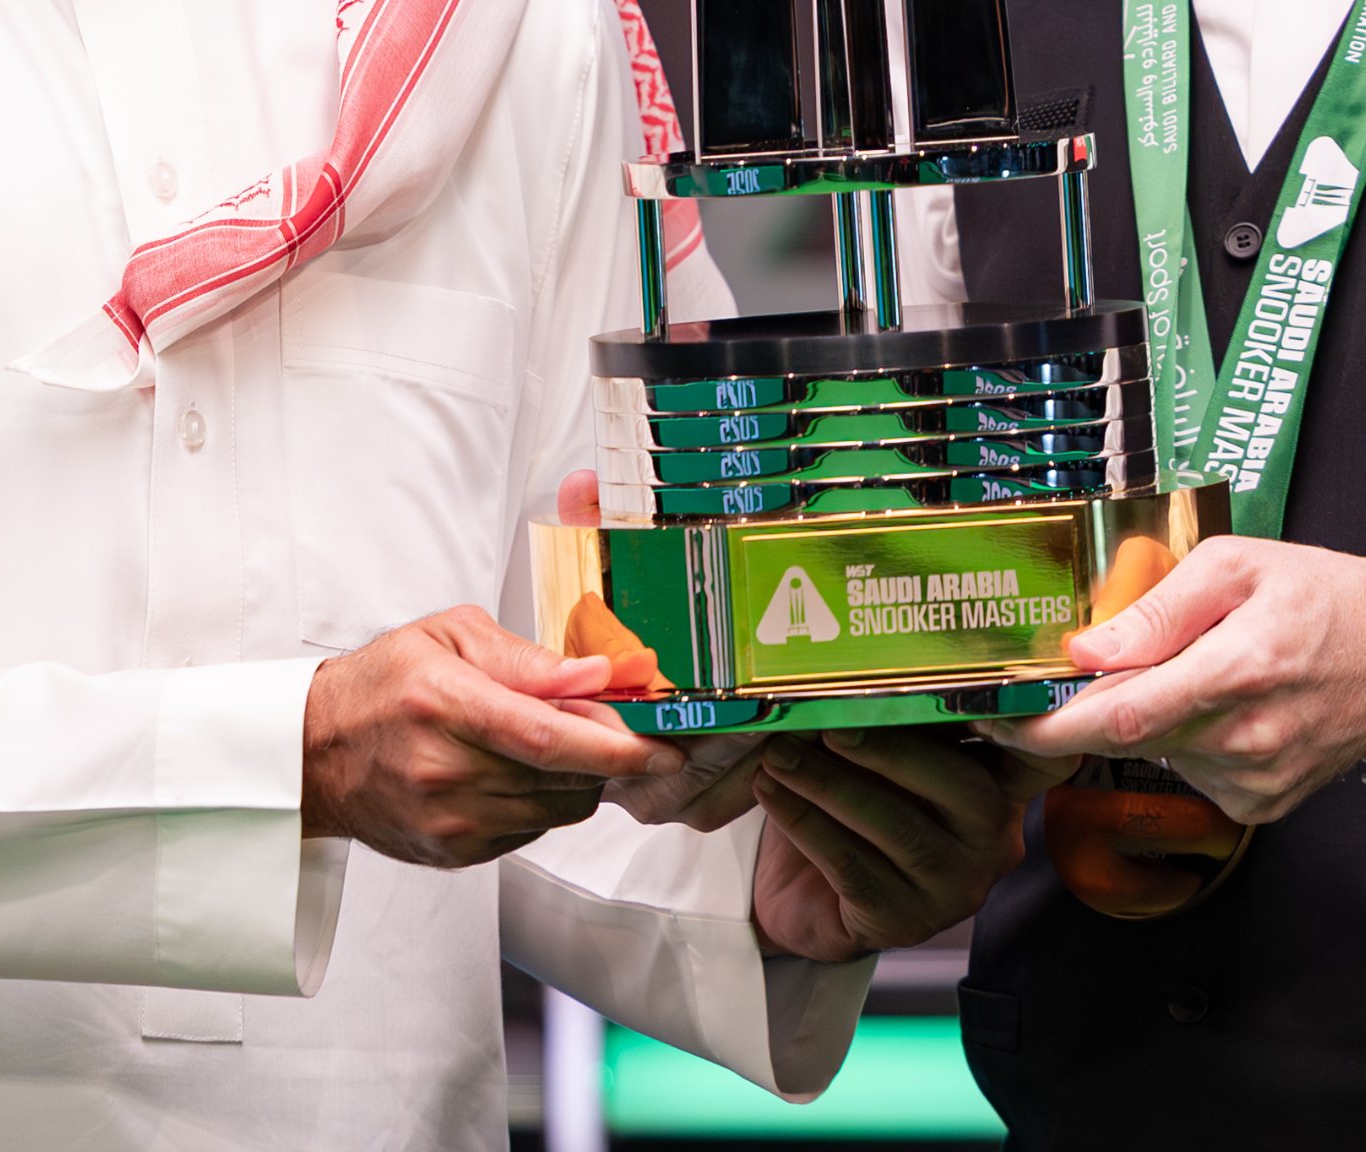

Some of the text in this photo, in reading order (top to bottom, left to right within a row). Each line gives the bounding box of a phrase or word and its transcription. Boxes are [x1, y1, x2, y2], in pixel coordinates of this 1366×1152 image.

[1162, 3, 1177, 32] AND
[1162, 39, 1177, 105] BILLIARD
[1136, 73, 1159, 147] والسنوكر
[1164, 108, 1177, 154] SAUDI
[1143, 228, 1172, 306] Sport
[1148, 309, 1171, 337] of
[1228, 253, 1303, 401] SNOOKER
[1235, 258, 1333, 493] SAUDI ARABIA
[845, 564, 874, 578] WST
[847, 569, 1019, 607] SAUDI ARABIA
[849, 595, 1072, 636] SNOOKER MASTERS
